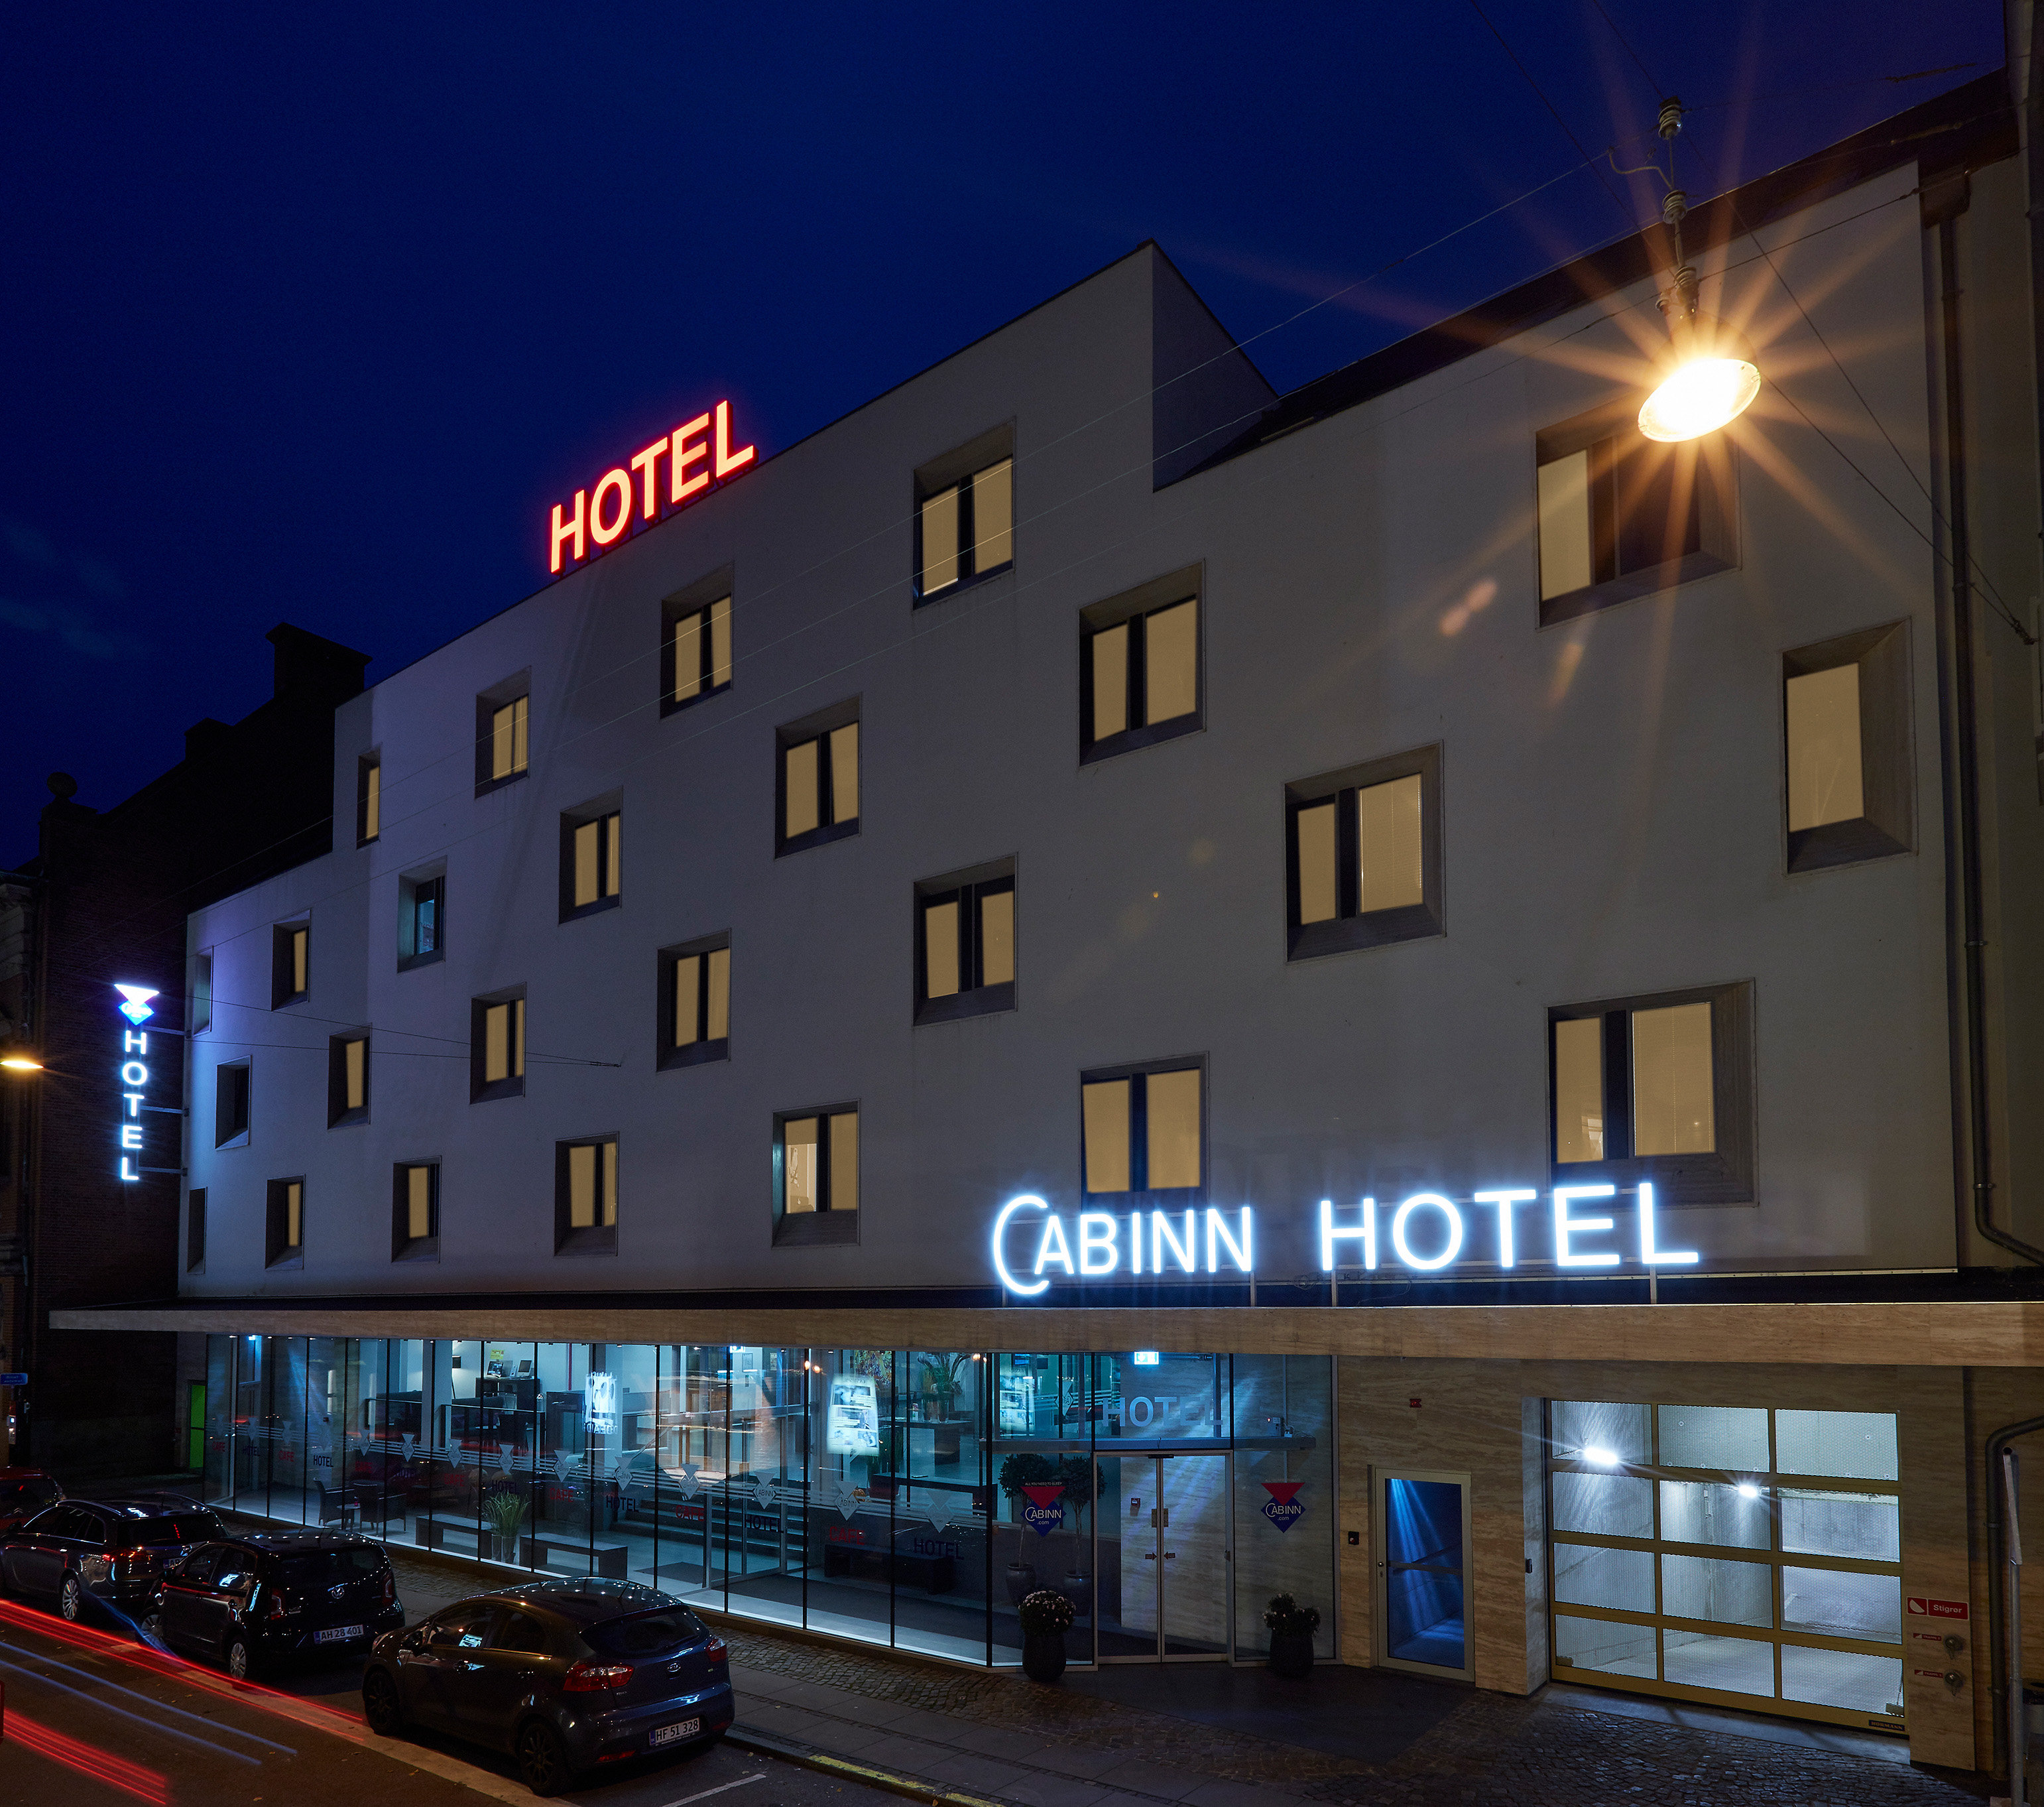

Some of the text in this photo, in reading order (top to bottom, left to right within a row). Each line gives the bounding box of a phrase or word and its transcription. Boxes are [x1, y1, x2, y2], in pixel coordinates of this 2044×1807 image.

[550, 399, 756, 574] HOTEL
[121, 1030, 148, 1180] HOTEL
[993, 1182, 1699, 1295] CABINN HOTEL
[1102, 1395, 1224, 1427] HOTEL
[278, 1450, 294, 1462] CAFE
[313, 1454, 334, 1467] HOTEL
[444, 1473, 465, 1487] CAFE
[550, 1487, 574, 1503] CAFE
[606, 1495, 639, 1513] HOTEL
[676, 1505, 705, 1522] CAFE
[1025, 1507, 1061, 1521] CABINN
[1266, 1503, 1301, 1517] CABINN
[744, 1514, 784, 1534] HOTEL
[829, 1527, 865, 1545] CAFE
[914, 1537, 965, 1560] HOTEL
[321, 1626, 361, 1641] AH 28 401
[656, 1728, 668, 1741] HF
[670, 1725, 680, 1737] 51
[683, 1719, 698, 1733] 328
